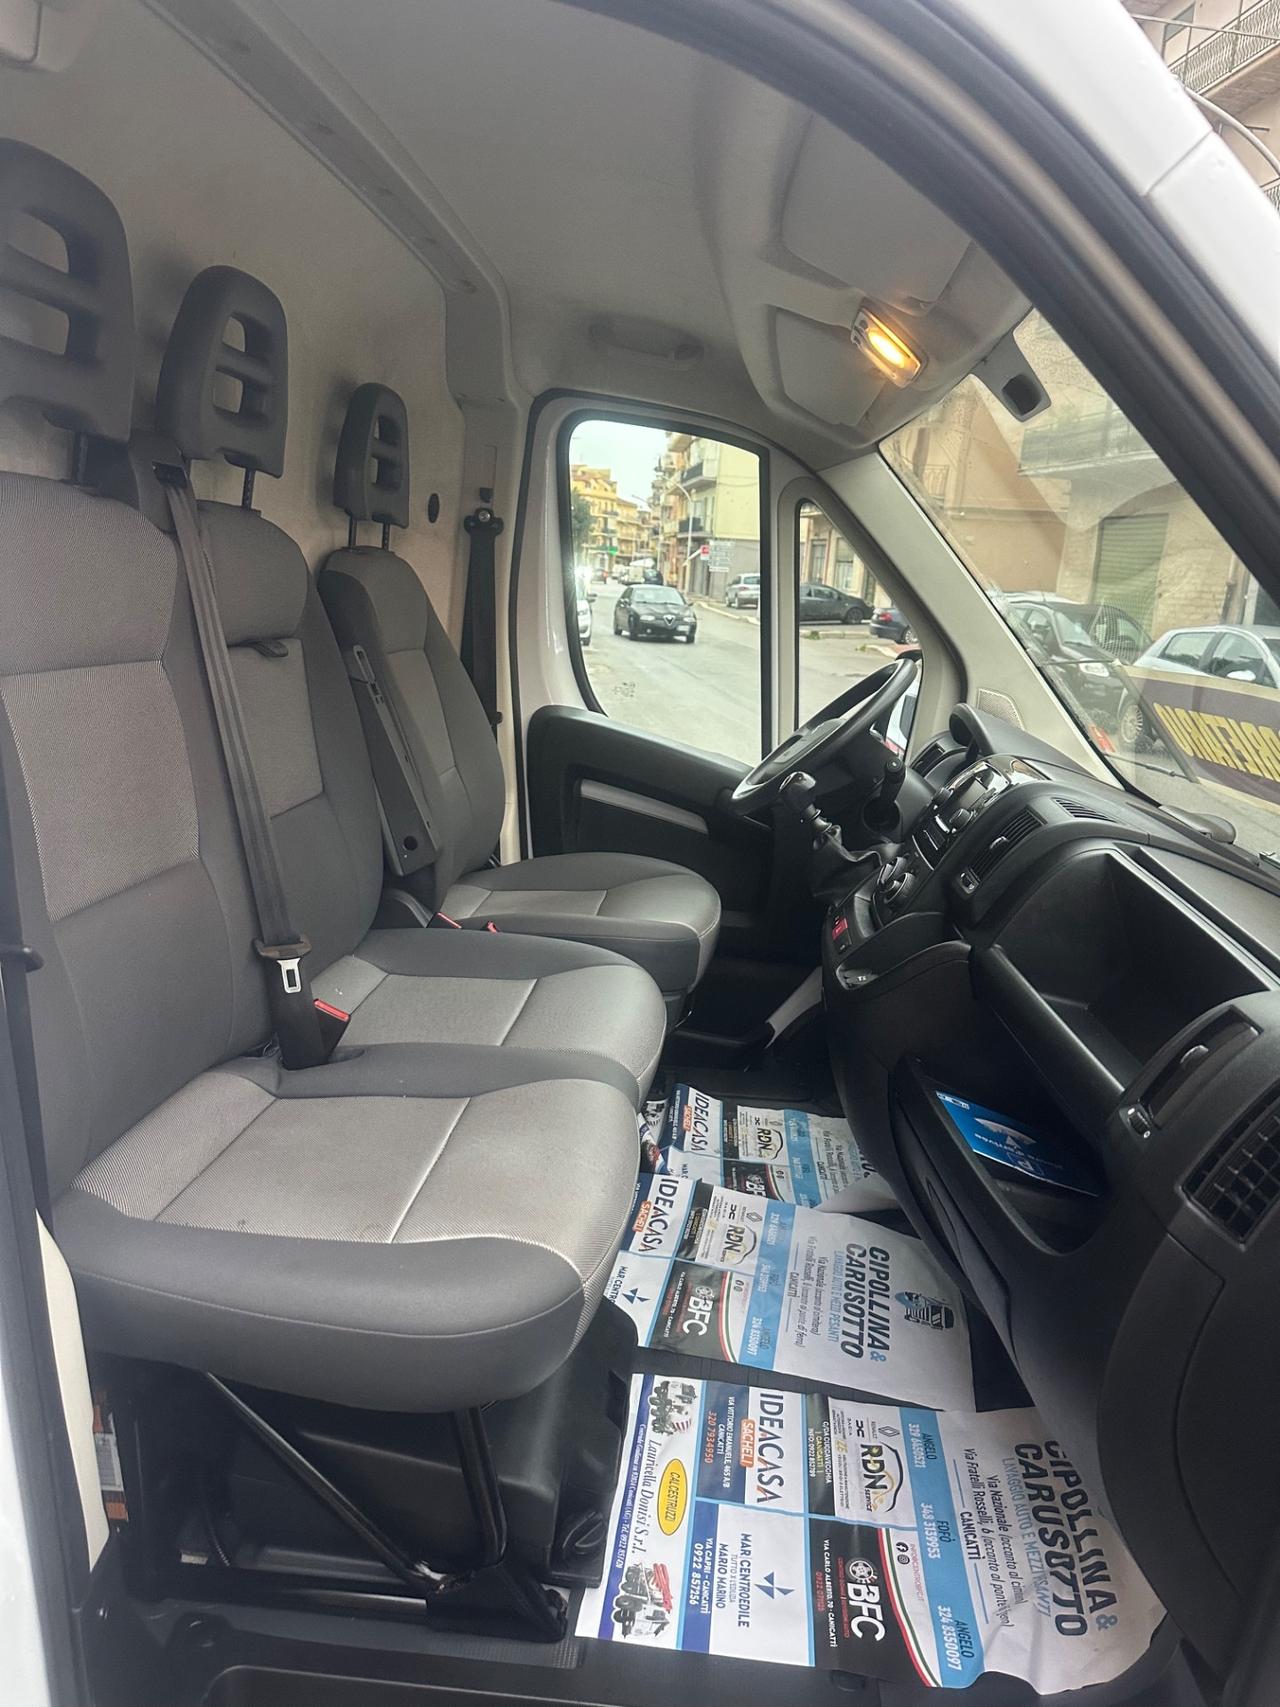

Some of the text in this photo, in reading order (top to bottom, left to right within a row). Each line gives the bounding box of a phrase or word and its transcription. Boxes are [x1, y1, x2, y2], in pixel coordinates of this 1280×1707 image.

[691, 1093, 710, 1151] IDEACASA
[757, 1128, 772, 1150] RDN
[746, 1181, 766, 1196] BF
[638, 1178, 679, 1252] IDEACASA
[724, 1225, 745, 1252] RDN
[617, 1266, 628, 1278] MAR
[682, 1296, 713, 1336] BFC
[840, 1243, 866, 1359] CARUSOTTO
[867, 1246, 890, 1362] CIPOLLINA &
[704, 1411, 717, 1464] 320 7934950
[727, 1406, 735, 1432] VITTORIO
[909, 1423, 920, 1437] 329
[741, 1421, 754, 1464] SACHELI
[756, 1393, 784, 1503] IDEACASA
[922, 1432, 938, 1460] ANGELO
[964, 1448, 977, 1461] Via
[642, 1439, 662, 1486] Lauricella
[860, 1444, 888, 1489] RDN
[968, 1461, 985, 1489] Fratelli
[986, 1475, 1001, 1488] Via
[636, 1488, 655, 1527] Donisi
[664, 1472, 681, 1521] CALCESTRUZZI
[865, 1489, 873, 1512] SERVICE
[973, 1490, 994, 1525] Rosselli,
[990, 1490, 1009, 1532] Nazionale
[1002, 1457, 1020, 1499] LAVAGGIO
[1014, 1500, 1033, 1529] AUTO
[1024, 1541, 1045, 1574] MEZZI
[705, 1538, 714, 1549] VIA
[920, 1503, 941, 1559] 348 3139953
[960, 1511, 986, 1560] CANICATTÌ
[704, 1551, 713, 1574] CAPRI
[980, 1535, 1002, 1571] (accanto
[998, 1533, 1018, 1570] (accanto
[689, 1543, 704, 1605] 0922 857256
[716, 1543, 728, 1609] MARIO MARINO
[738, 1533, 752, 1628] MAR CENTROEDILE
[991, 1573, 1006, 1583] al
[1009, 1571, 1024, 1580] al
[846, 1582, 886, 1641] BFC
[1096, 1614, 1118, 1631] &
[938, 1605, 962, 1671] 324 8350097
[954, 1620, 975, 1659] ANGELO
